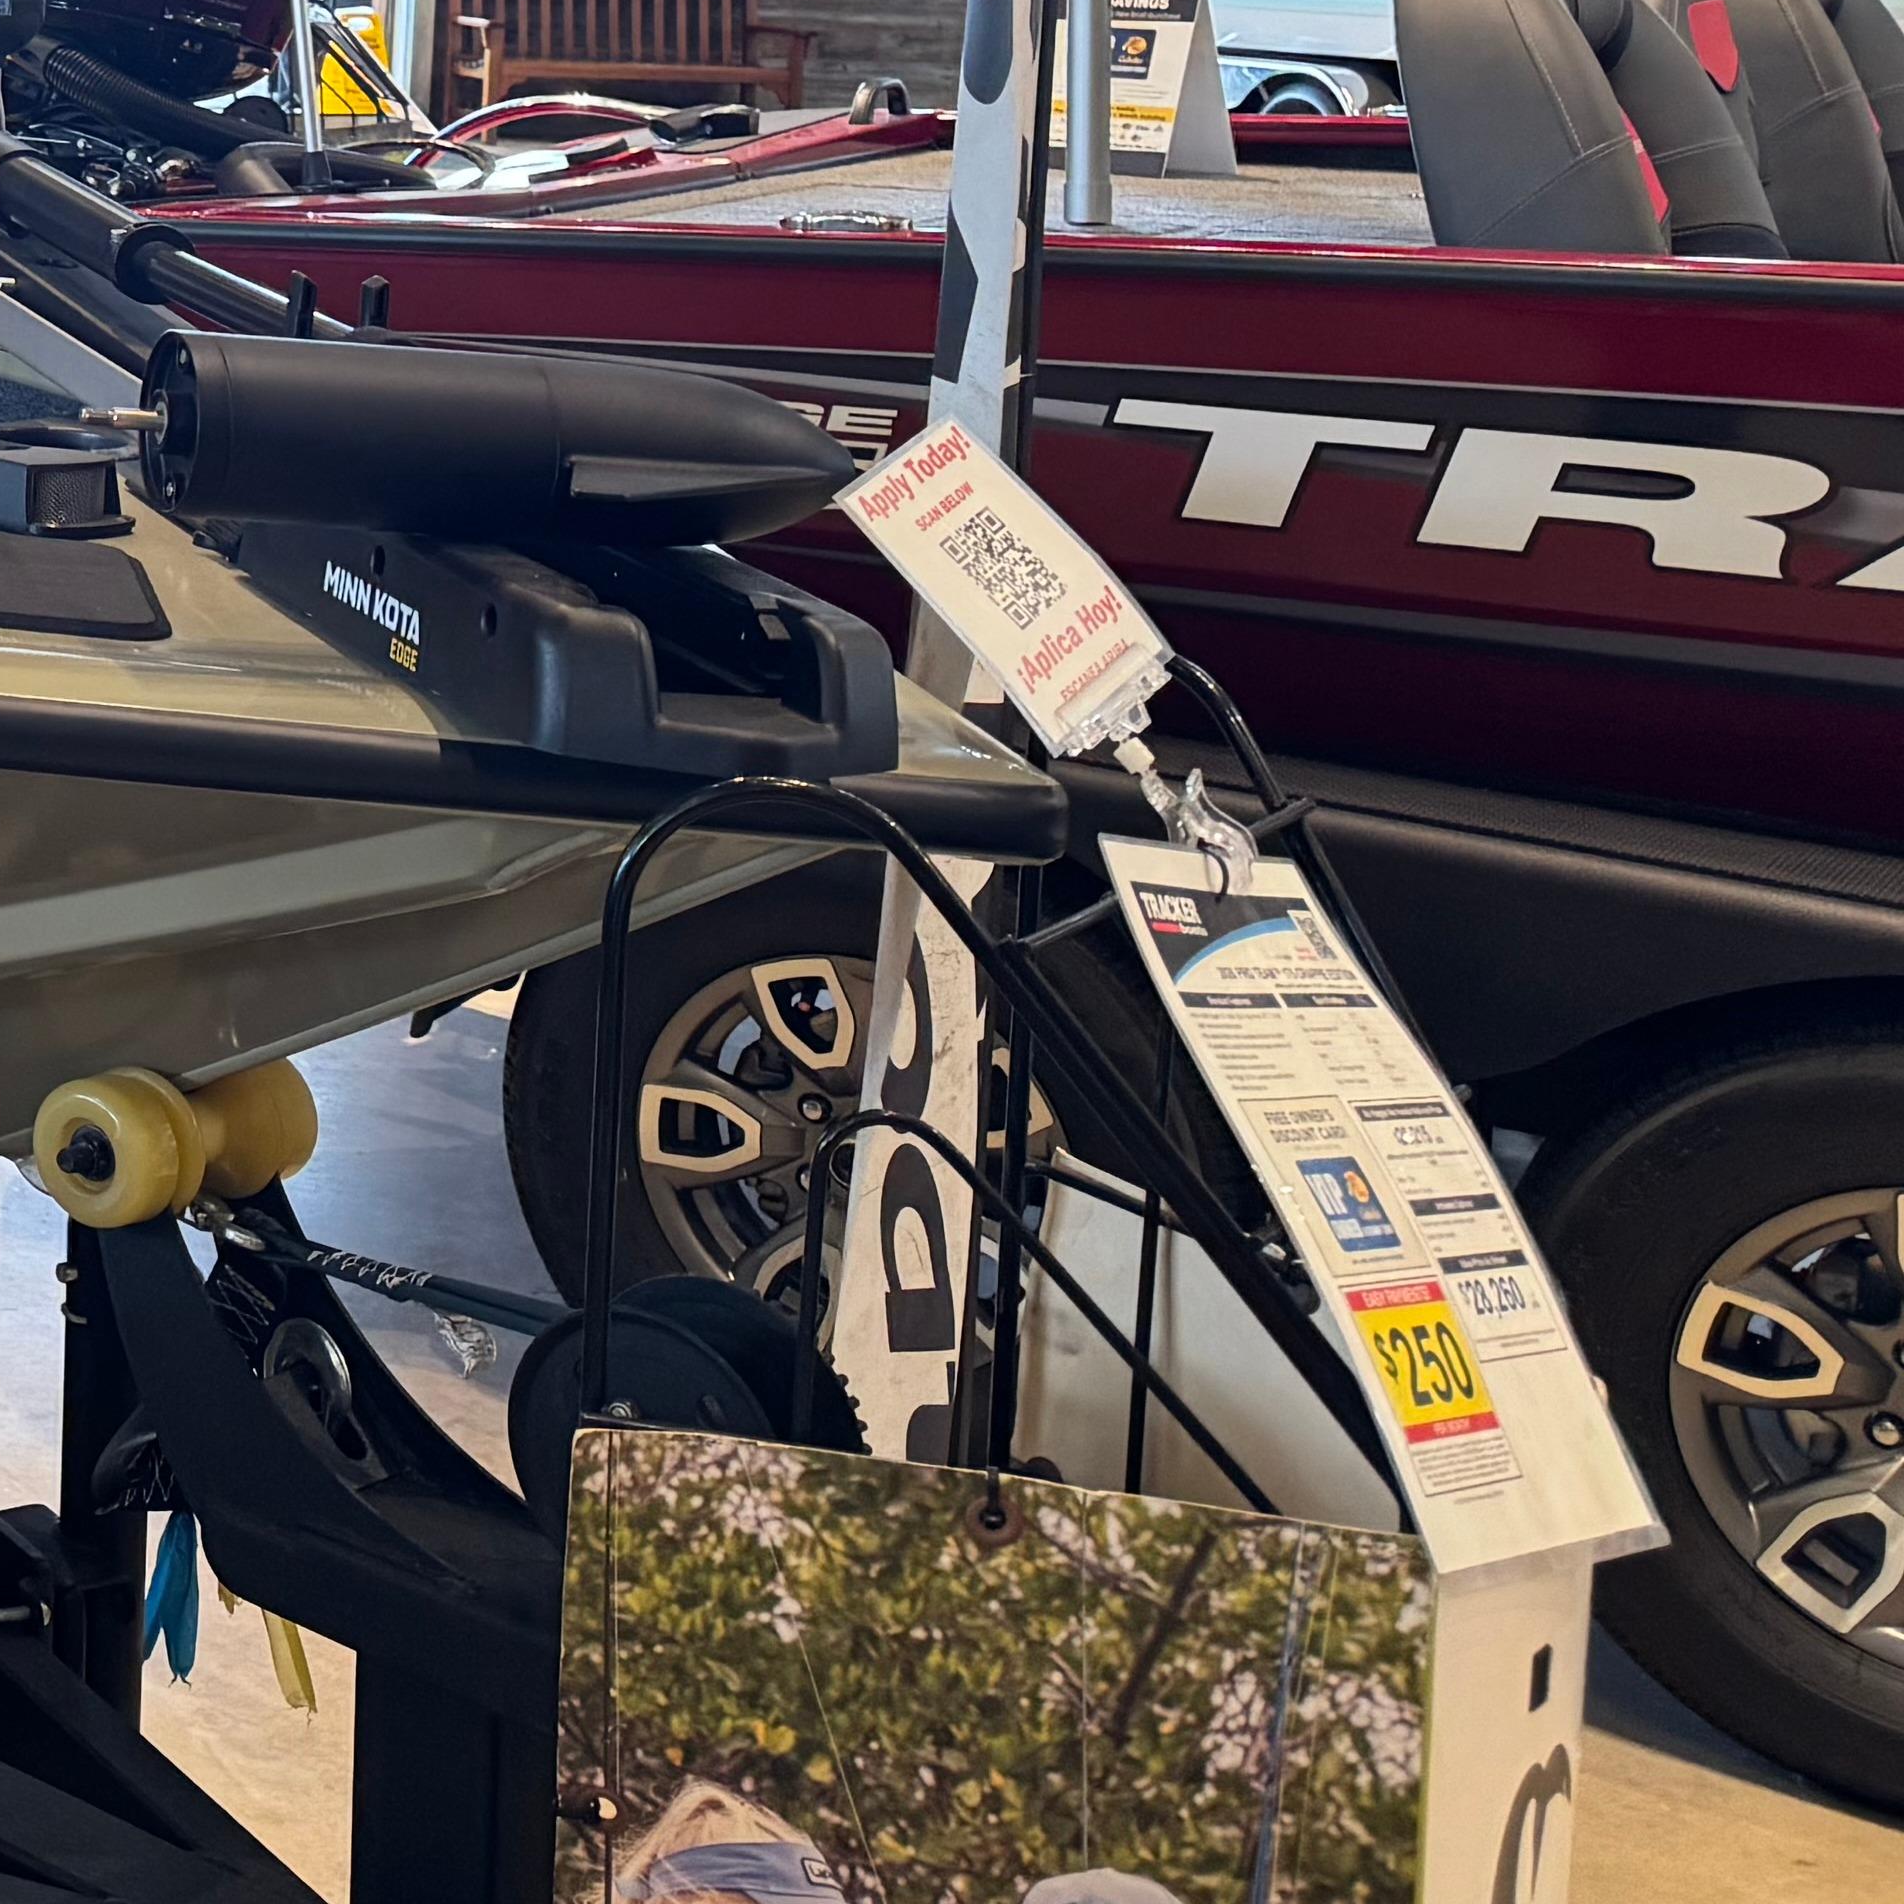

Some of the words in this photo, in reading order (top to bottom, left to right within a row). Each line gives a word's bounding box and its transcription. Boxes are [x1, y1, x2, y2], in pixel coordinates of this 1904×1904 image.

[858, 470, 916, 522] Apply
[903, 425, 973, 485] Today!
[914, 503, 943, 532] SCAN
[938, 480, 976, 515] BELOW
[1112, 397, 1904, 595] TR
[323, 560, 375, 619] MINN
[371, 584, 422, 646] KOTA
[1016, 624, 1084, 694] ¡Aplica
[1074, 584, 1124, 636] Hoy!
[388, 637, 421, 673] EDGE
[1138, 891, 1202, 925] TRACKER
[1458, 1275, 1527, 1320] $28,260
[1373, 1321, 1475, 1407] $250
